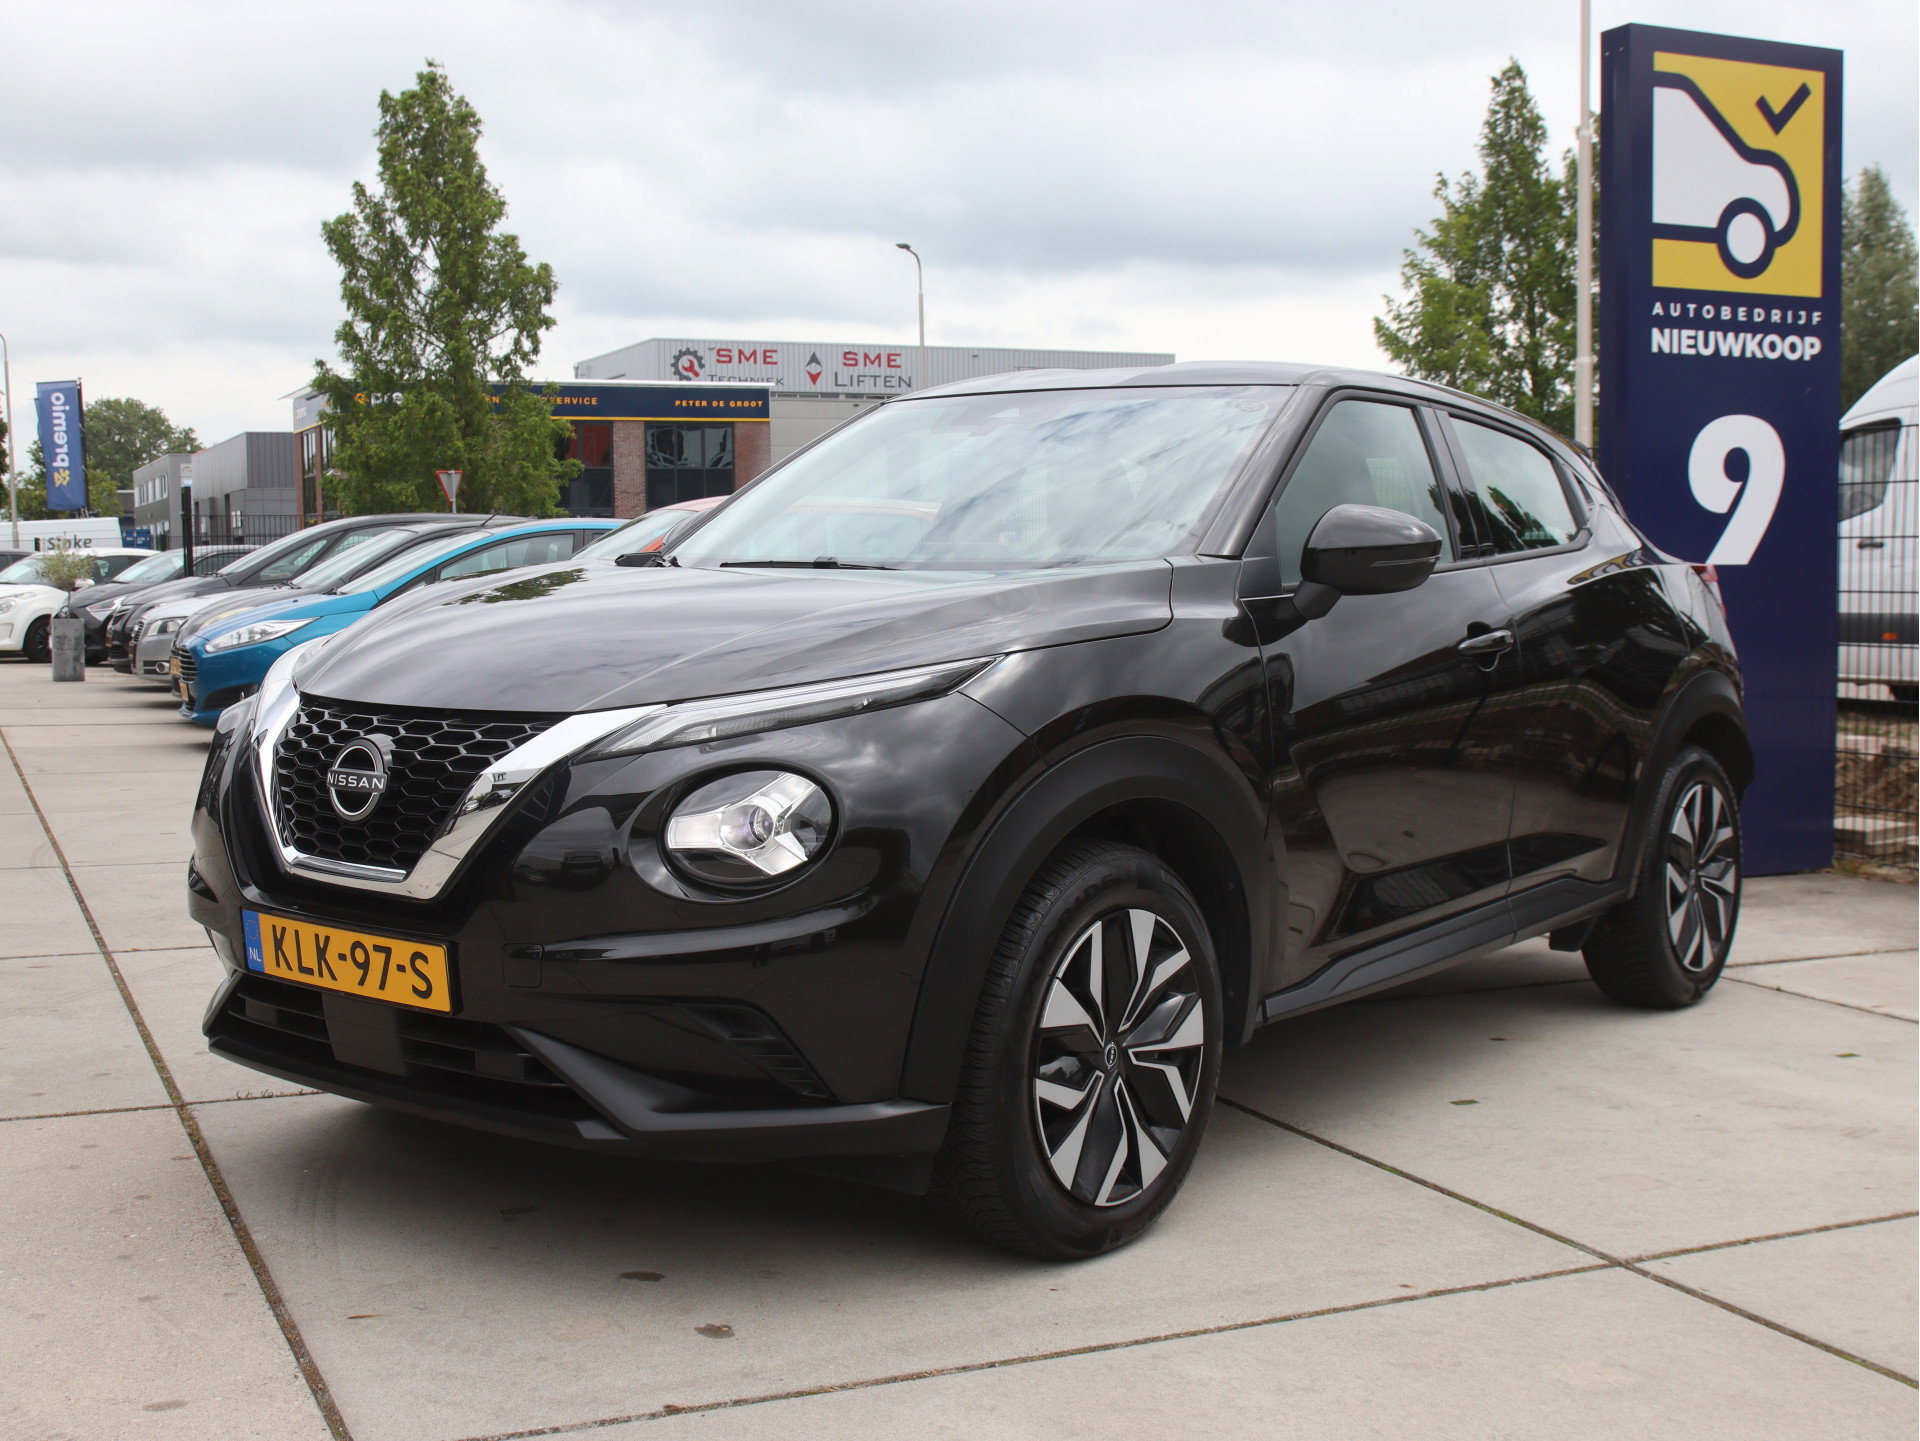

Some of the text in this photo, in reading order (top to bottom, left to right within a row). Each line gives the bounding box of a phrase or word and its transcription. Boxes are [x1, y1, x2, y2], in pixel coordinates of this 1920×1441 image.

[1652, 301, 1822, 326] AUTOBEDRIJF
[1651, 327, 1822, 361] NIEUWKOOP
[716, 348, 778, 365] SME
[843, 351, 902, 368] SME
[834, 371, 912, 388] LIFTEN
[730, 400, 763, 408] GROOT
[1688, 414, 1785, 565] 9
[327, 773, 384, 790] NISSAN
[249, 924, 433, 1000] NL KLK-97-S
